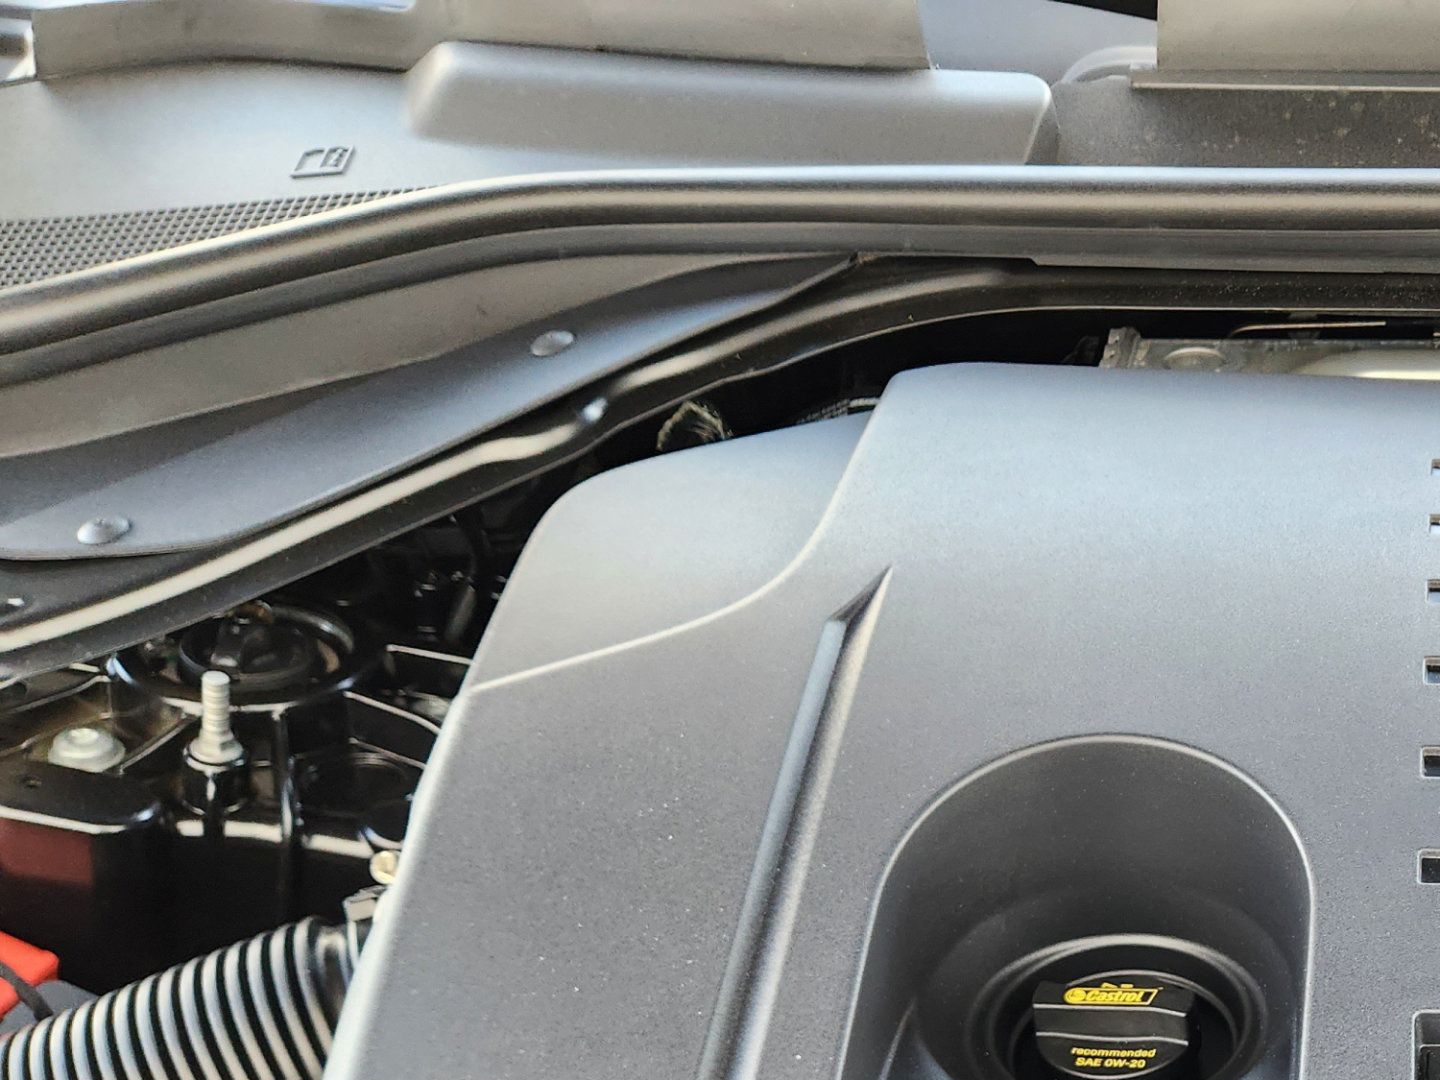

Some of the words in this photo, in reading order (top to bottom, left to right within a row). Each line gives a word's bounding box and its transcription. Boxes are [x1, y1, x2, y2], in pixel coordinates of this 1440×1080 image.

[1085, 988, 1145, 1003] Castrol
[1071, 1047, 1156, 1058] recommended
[1075, 1057, 1102, 1067] SAE
[1103, 1058, 1147, 1069] 0W-20
